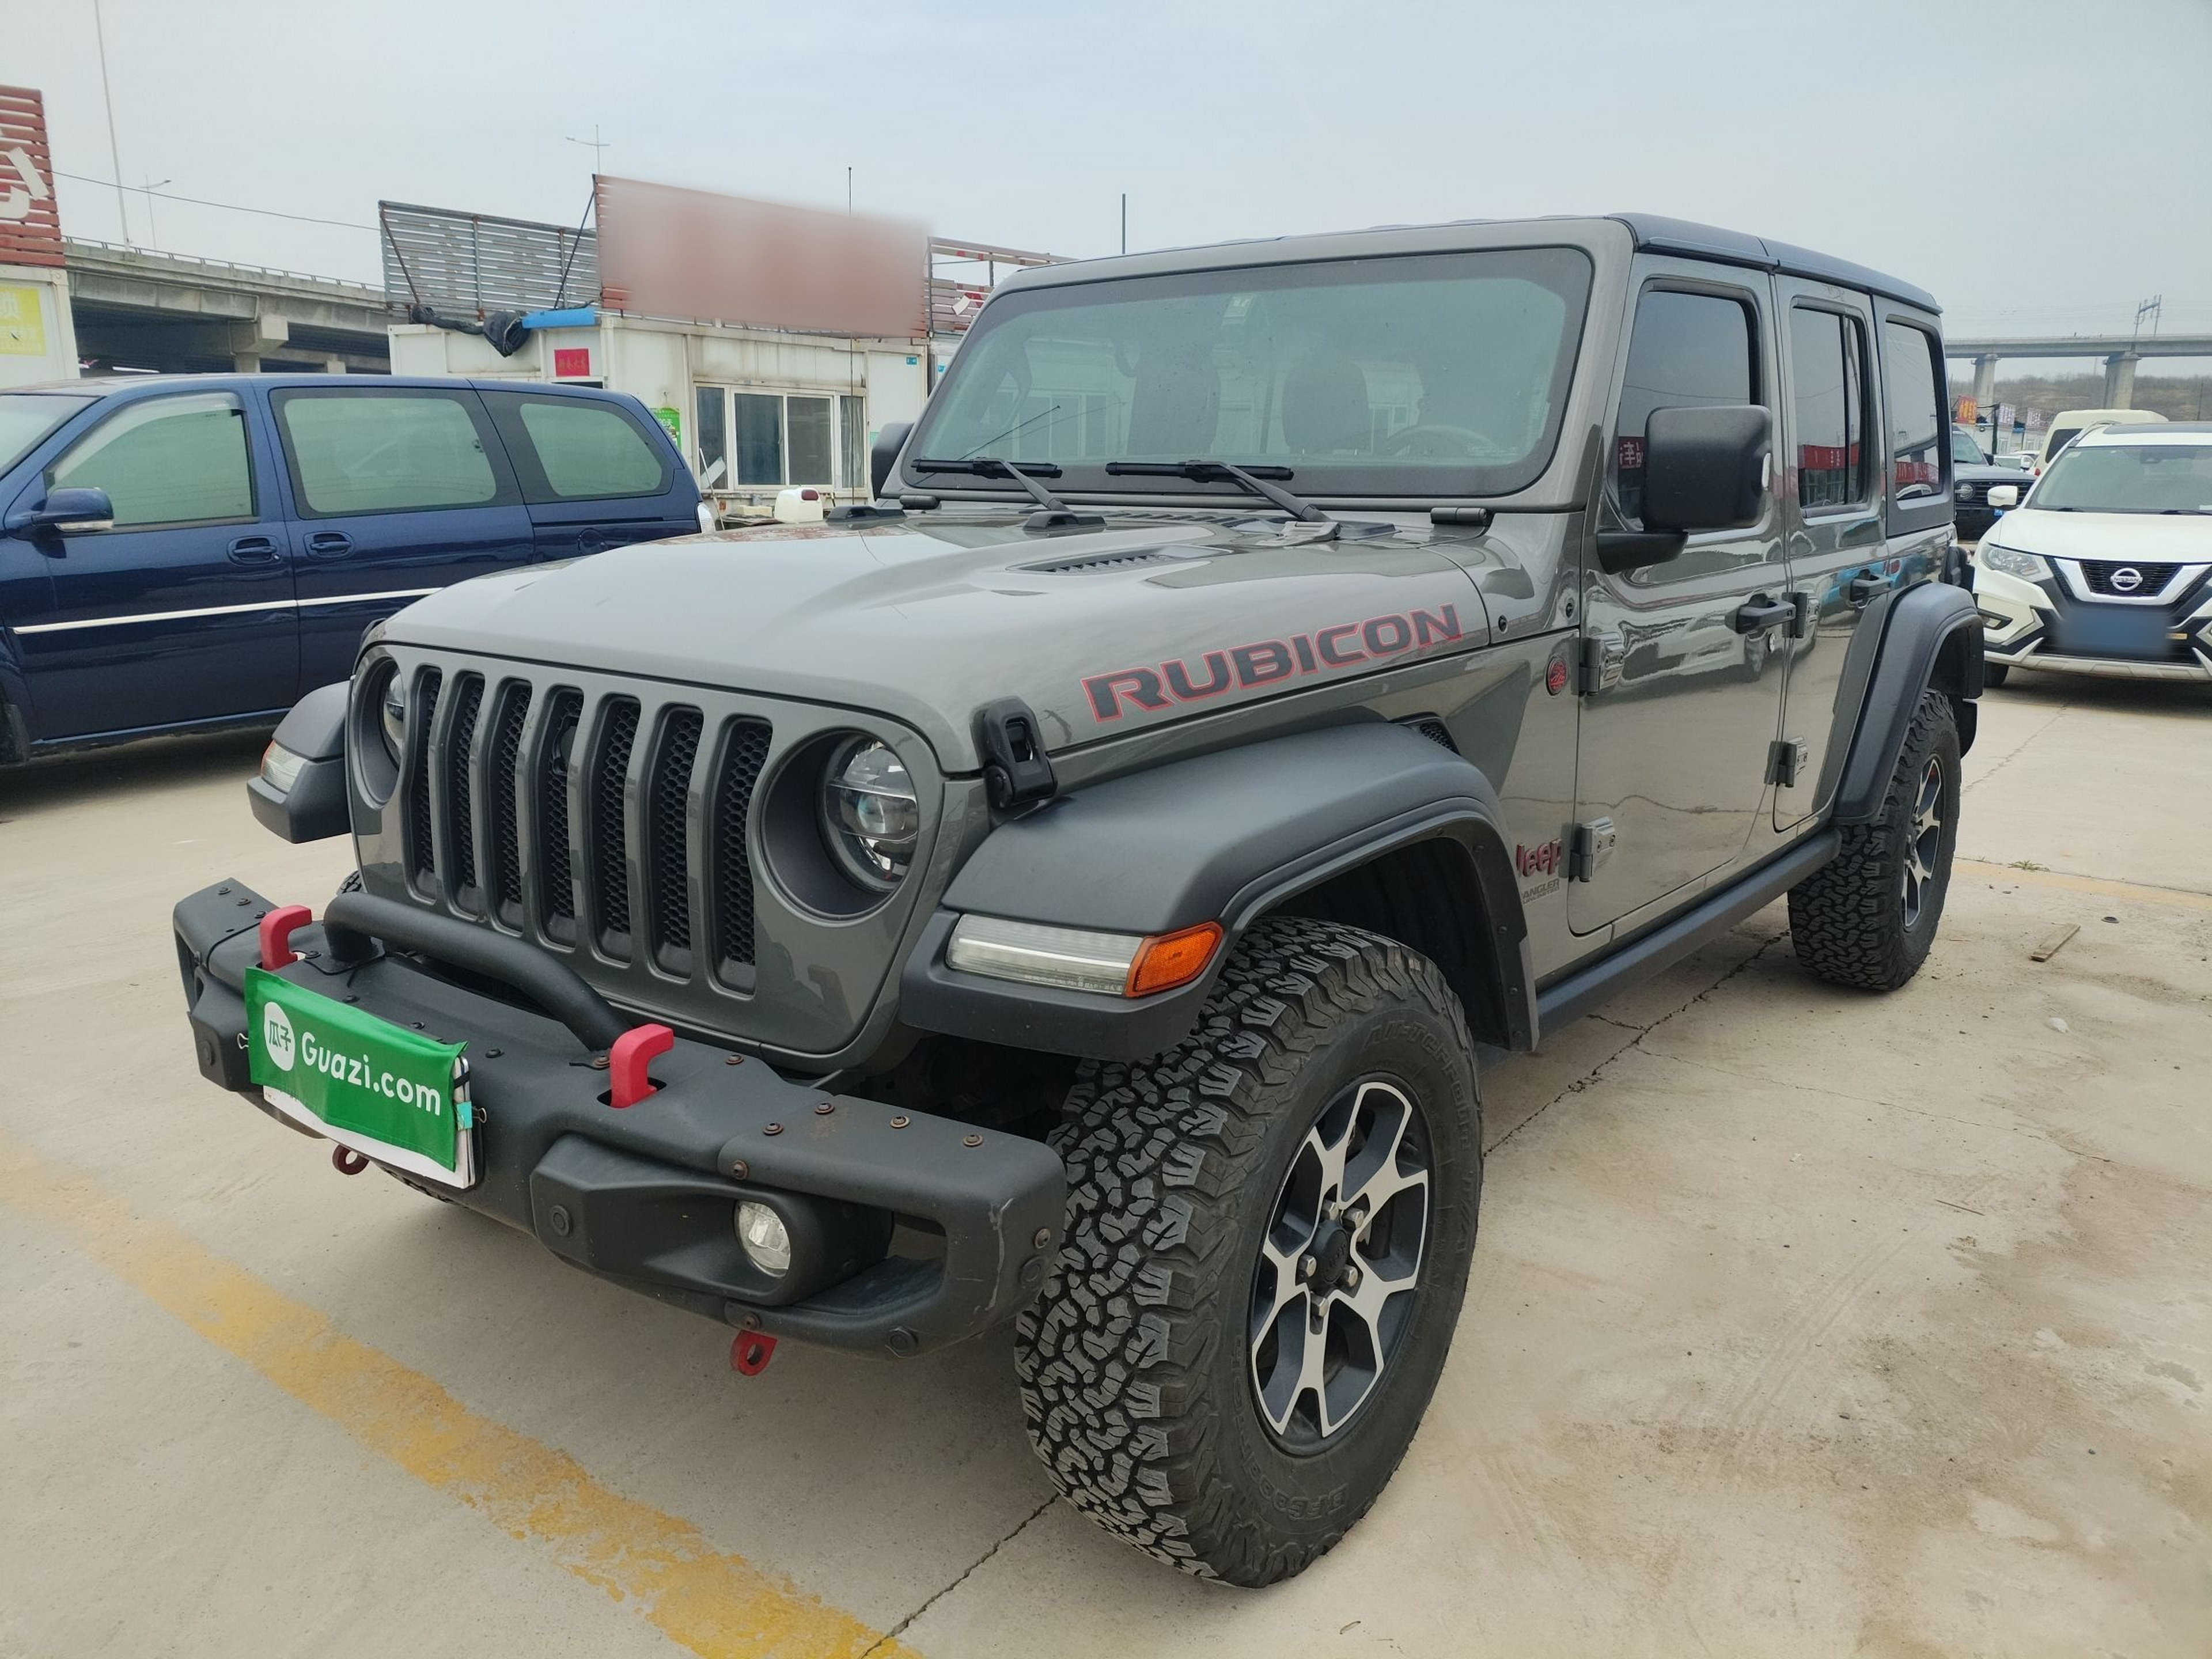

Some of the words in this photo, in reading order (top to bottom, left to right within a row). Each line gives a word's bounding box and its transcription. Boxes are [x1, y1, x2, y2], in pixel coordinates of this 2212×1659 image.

[1080, 603, 1463, 723] RUBICON
[1516, 839, 1562, 876] Jeep
[1521, 878, 1559, 900] ANGLER
[268, 1020, 292, 1052] 瓜子
[301, 1031, 441, 1116] Guazi.com
